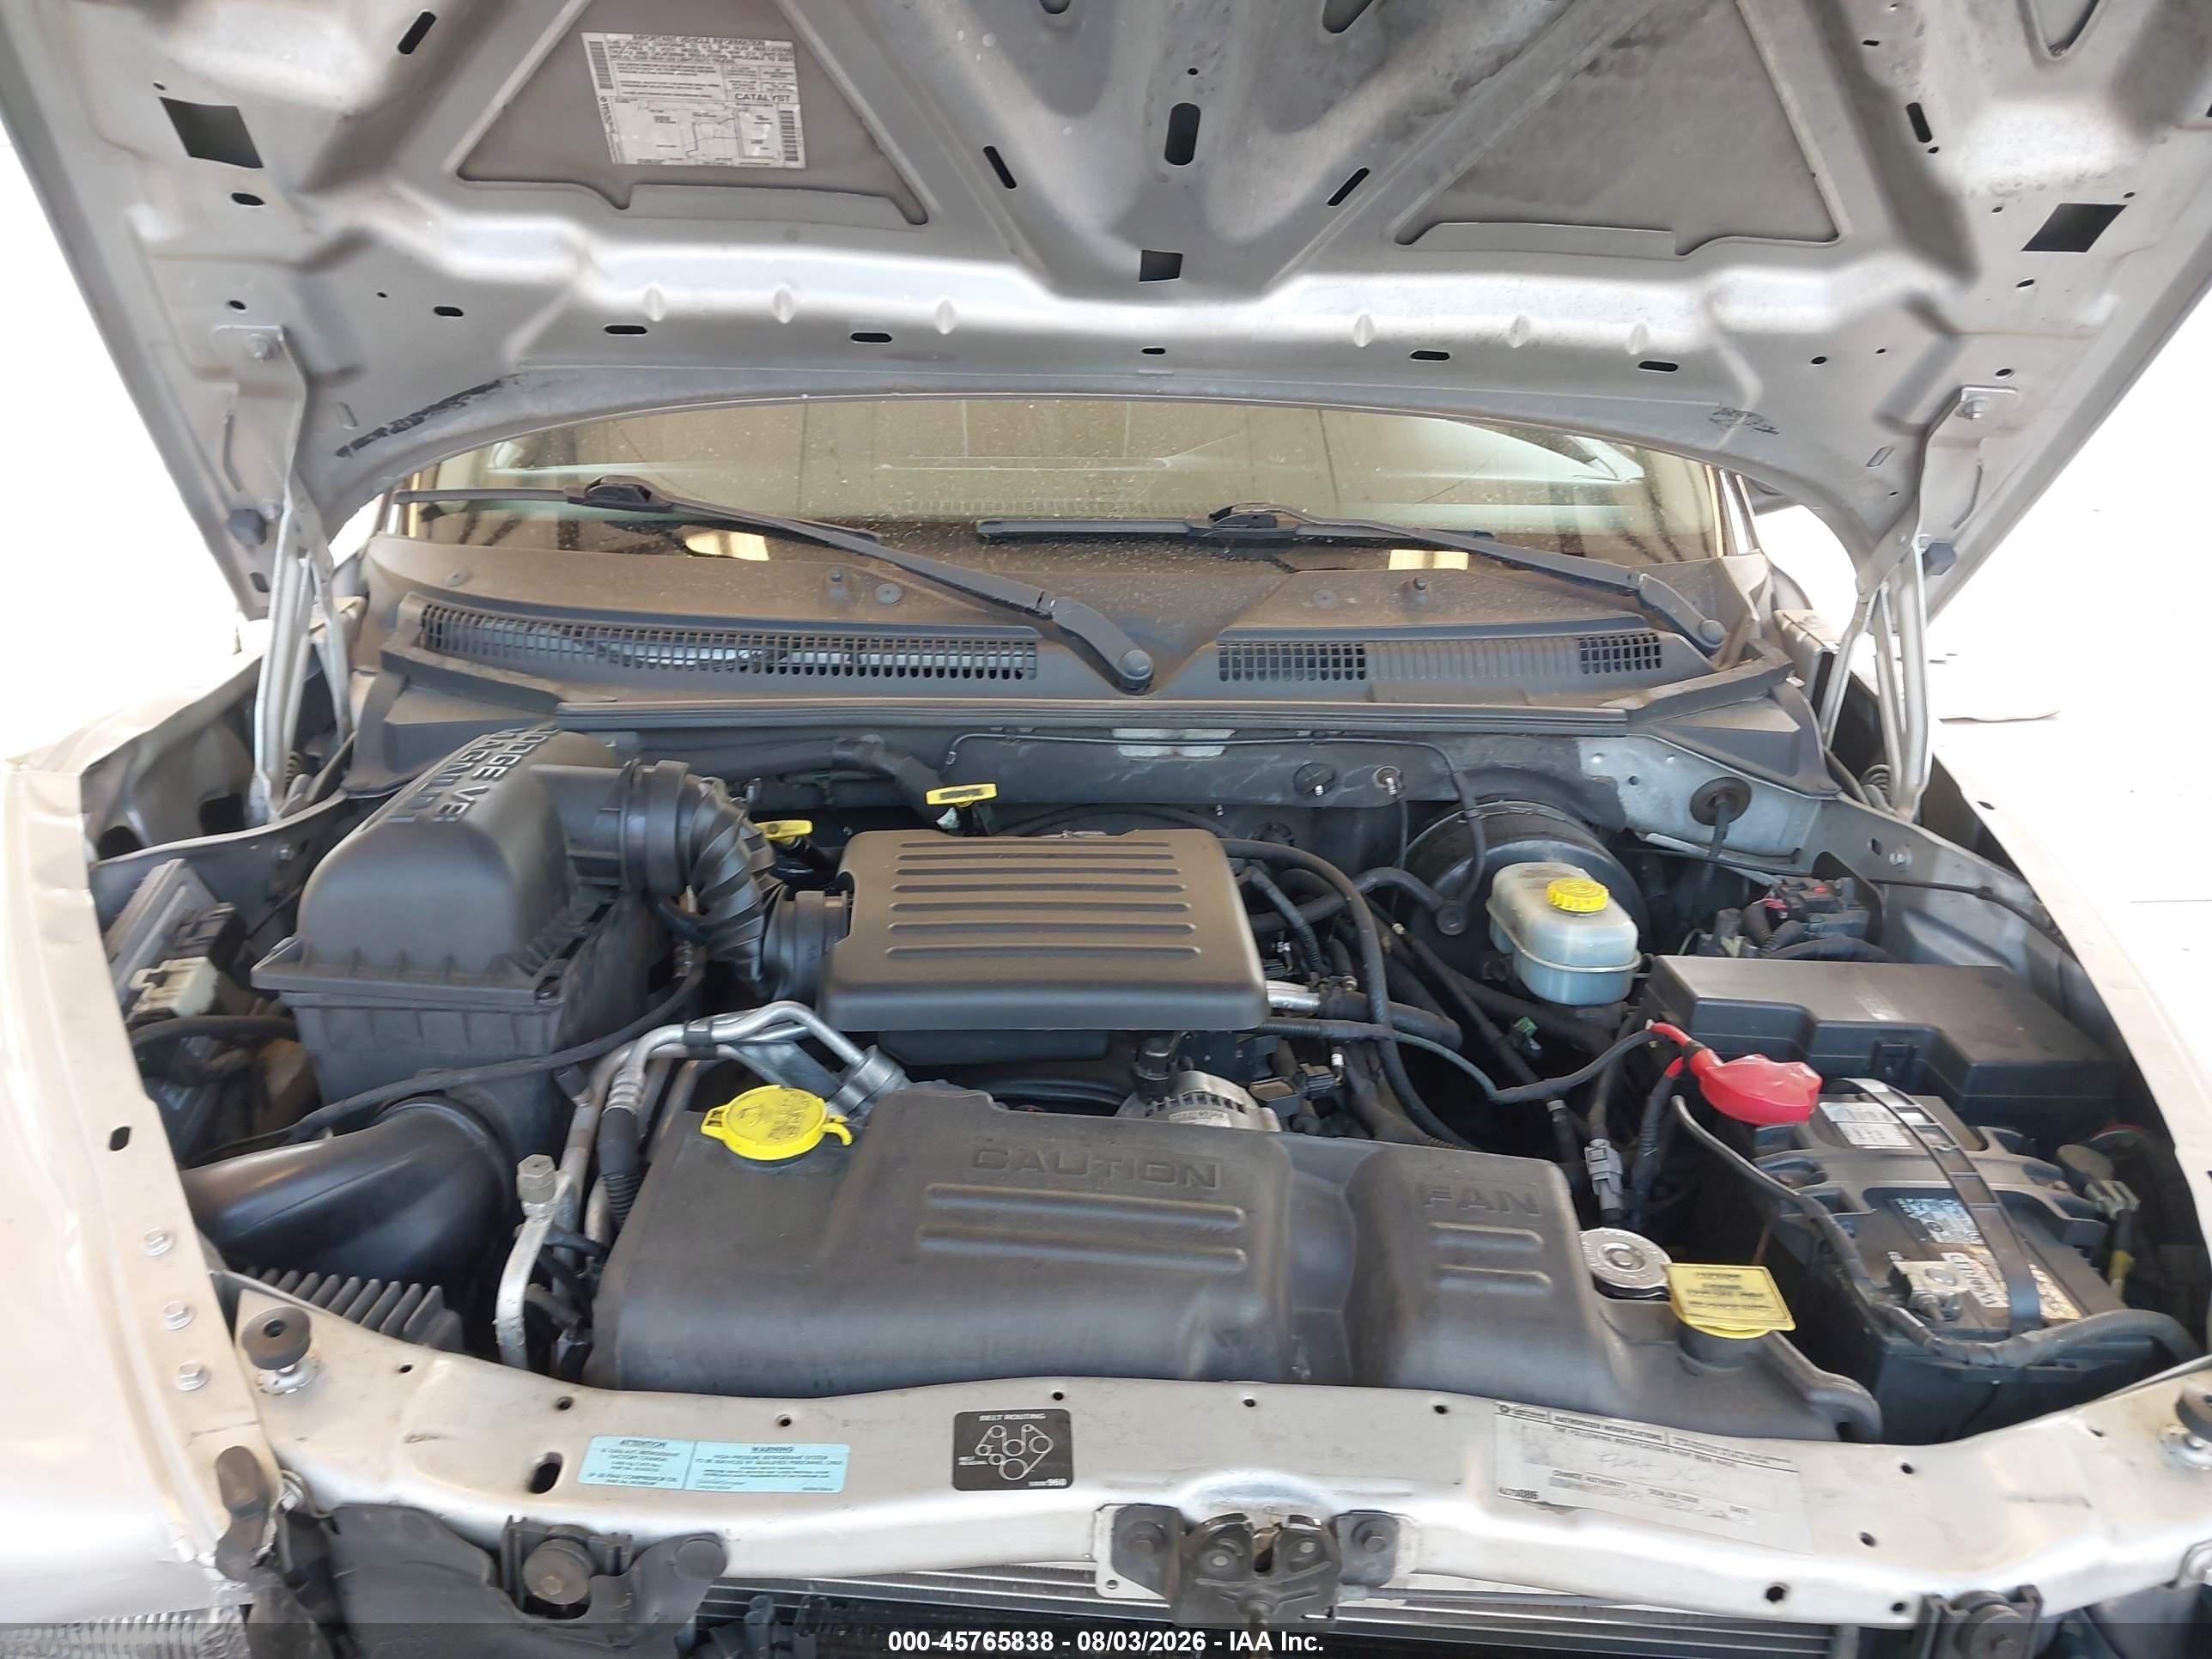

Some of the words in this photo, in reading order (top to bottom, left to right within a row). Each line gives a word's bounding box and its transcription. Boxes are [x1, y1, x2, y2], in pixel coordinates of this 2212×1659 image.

[734, 93, 792, 102] CATALYST
[471, 726, 560, 781] DODGE
[432, 785, 489, 823] V8
[971, 1146, 1219, 1190] CAUTION
[1423, 1180, 1540, 1217] FAN
